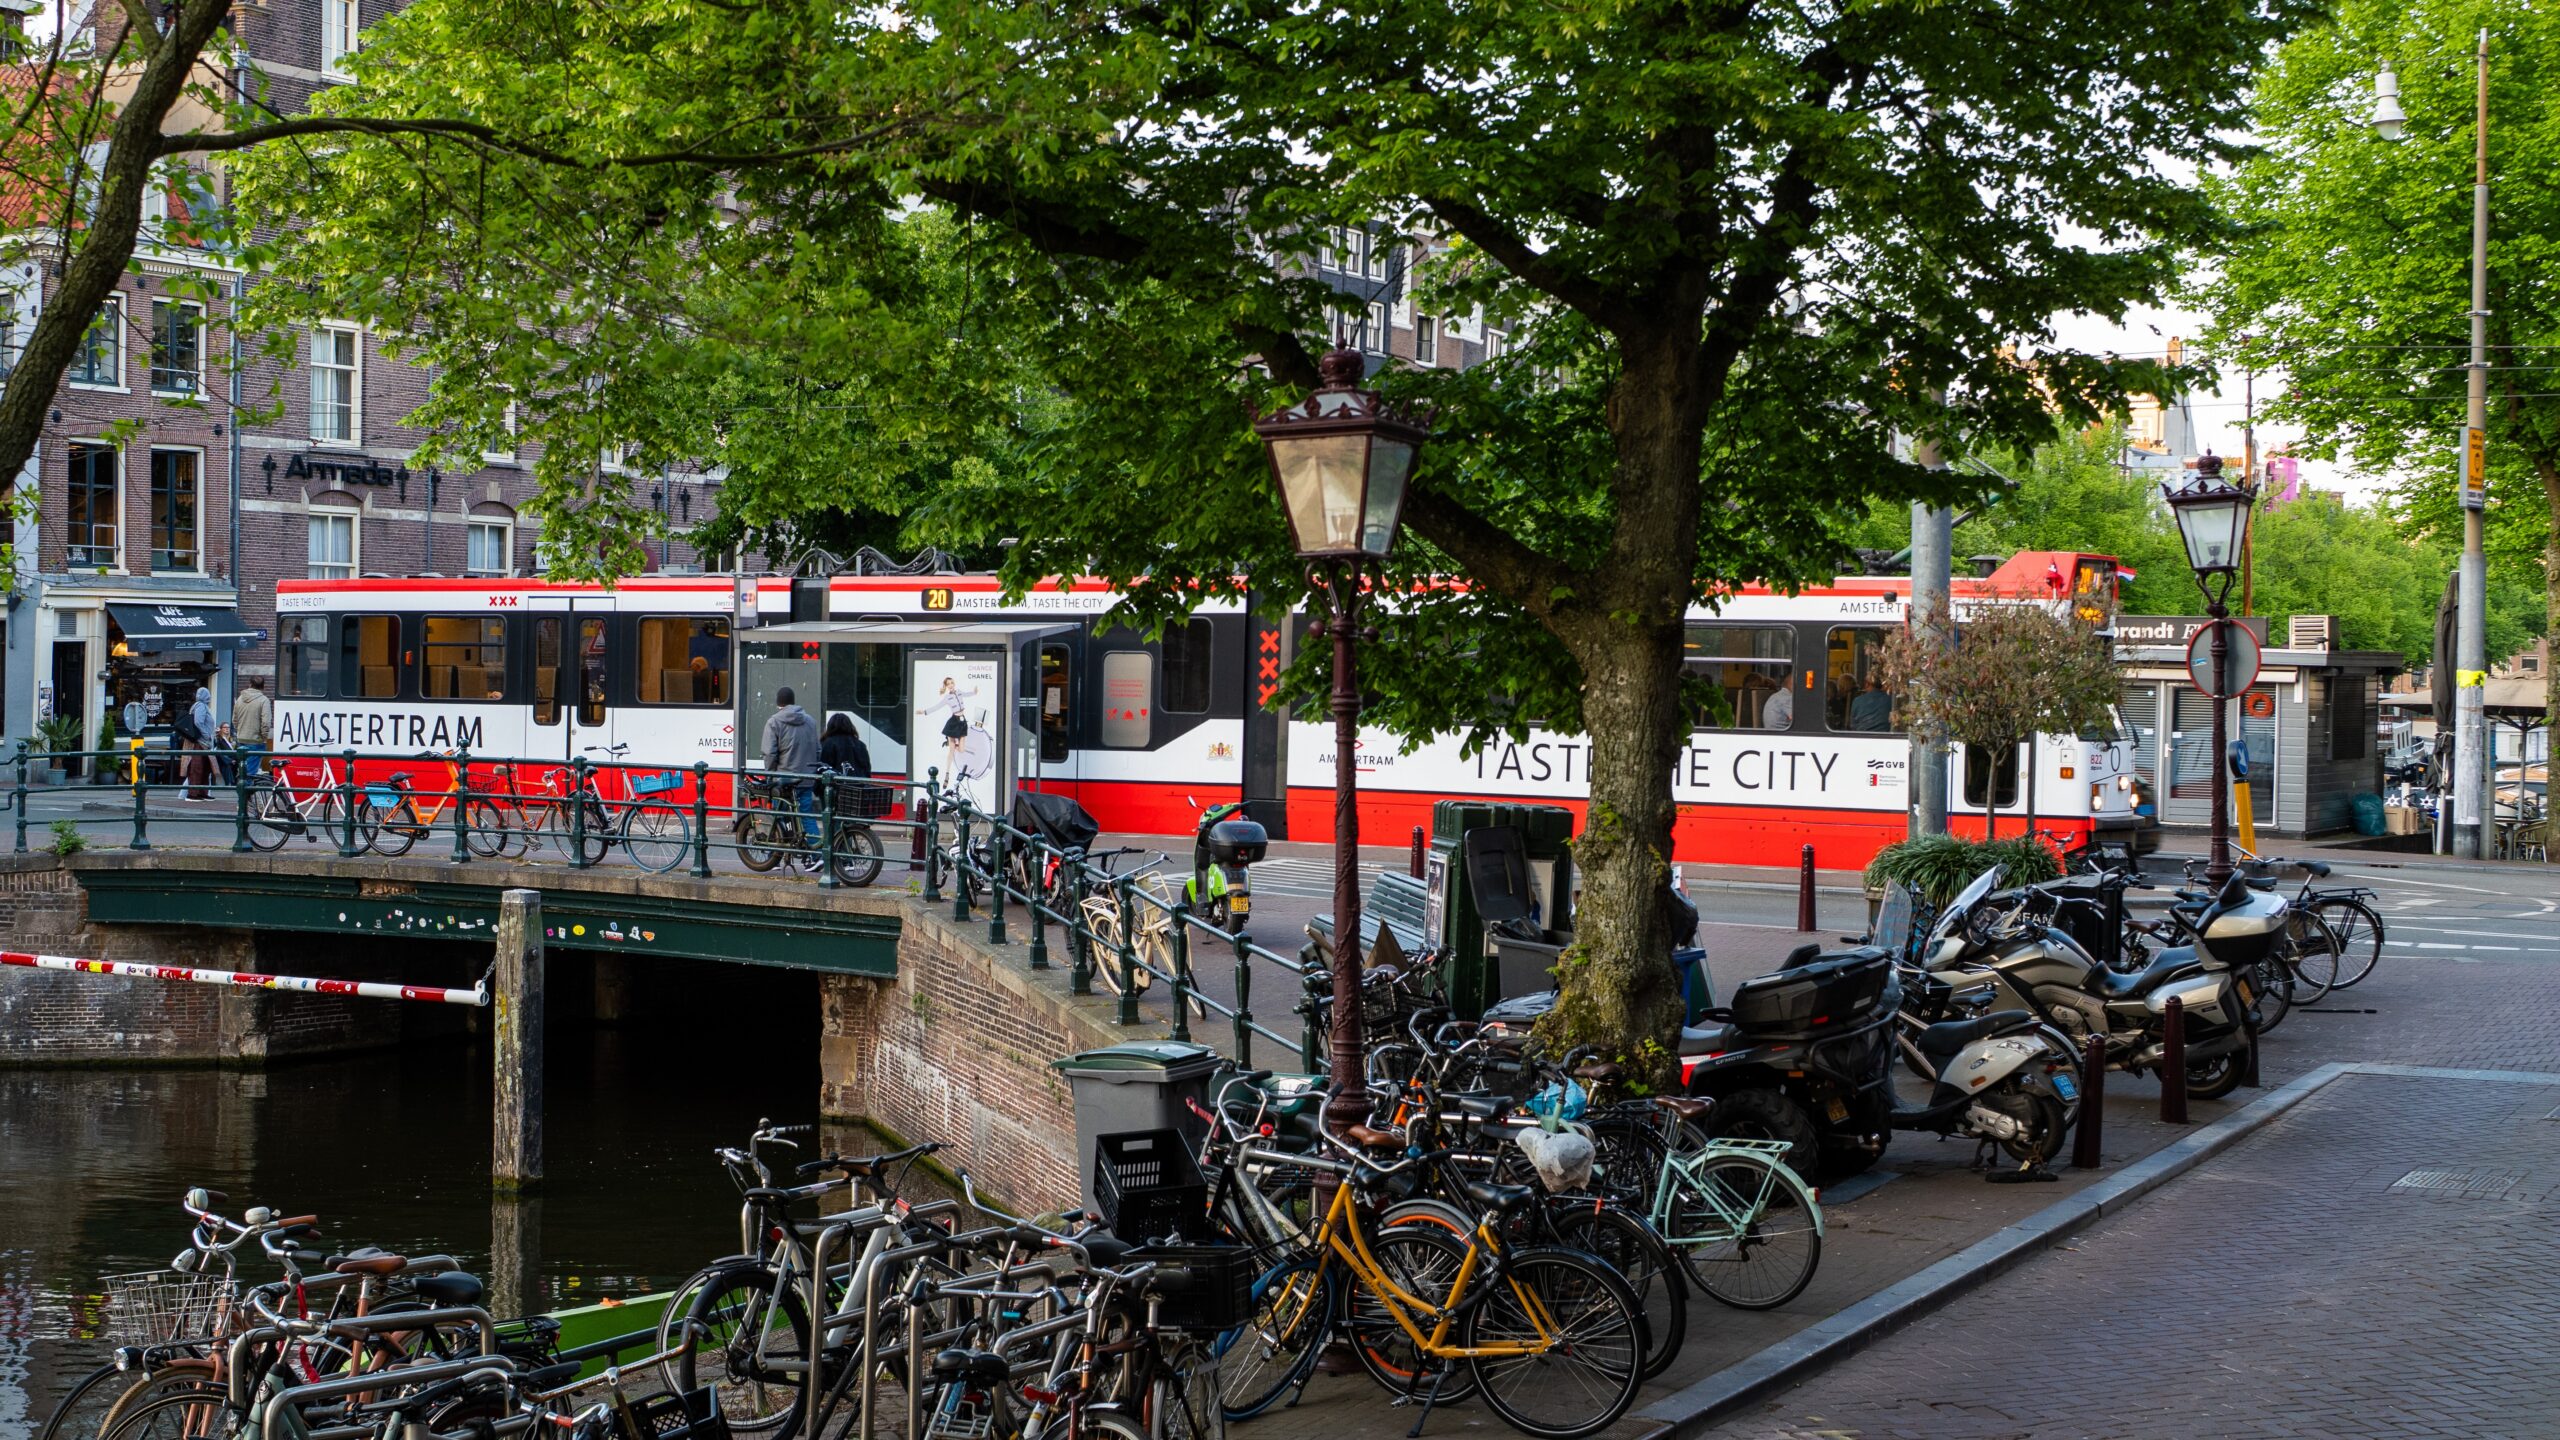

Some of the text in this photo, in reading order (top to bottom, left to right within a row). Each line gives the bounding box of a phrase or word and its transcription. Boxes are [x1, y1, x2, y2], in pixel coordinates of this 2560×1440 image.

[282, 597, 326, 607] TASTE THE CITY
[928, 590, 947, 608] 20
[956, 598, 1103, 609] AMSTERM, TASTE THE CITY
[153, 616, 207, 627] BRASSERIE
[280, 712, 483, 748] AMSTERTRAM
[1319, 754, 1394, 766] AMRTRAM
[1885, 761, 1905, 769] GVB
[2091, 755, 2102, 764] 822
[1733, 750, 1839, 792] CITY
